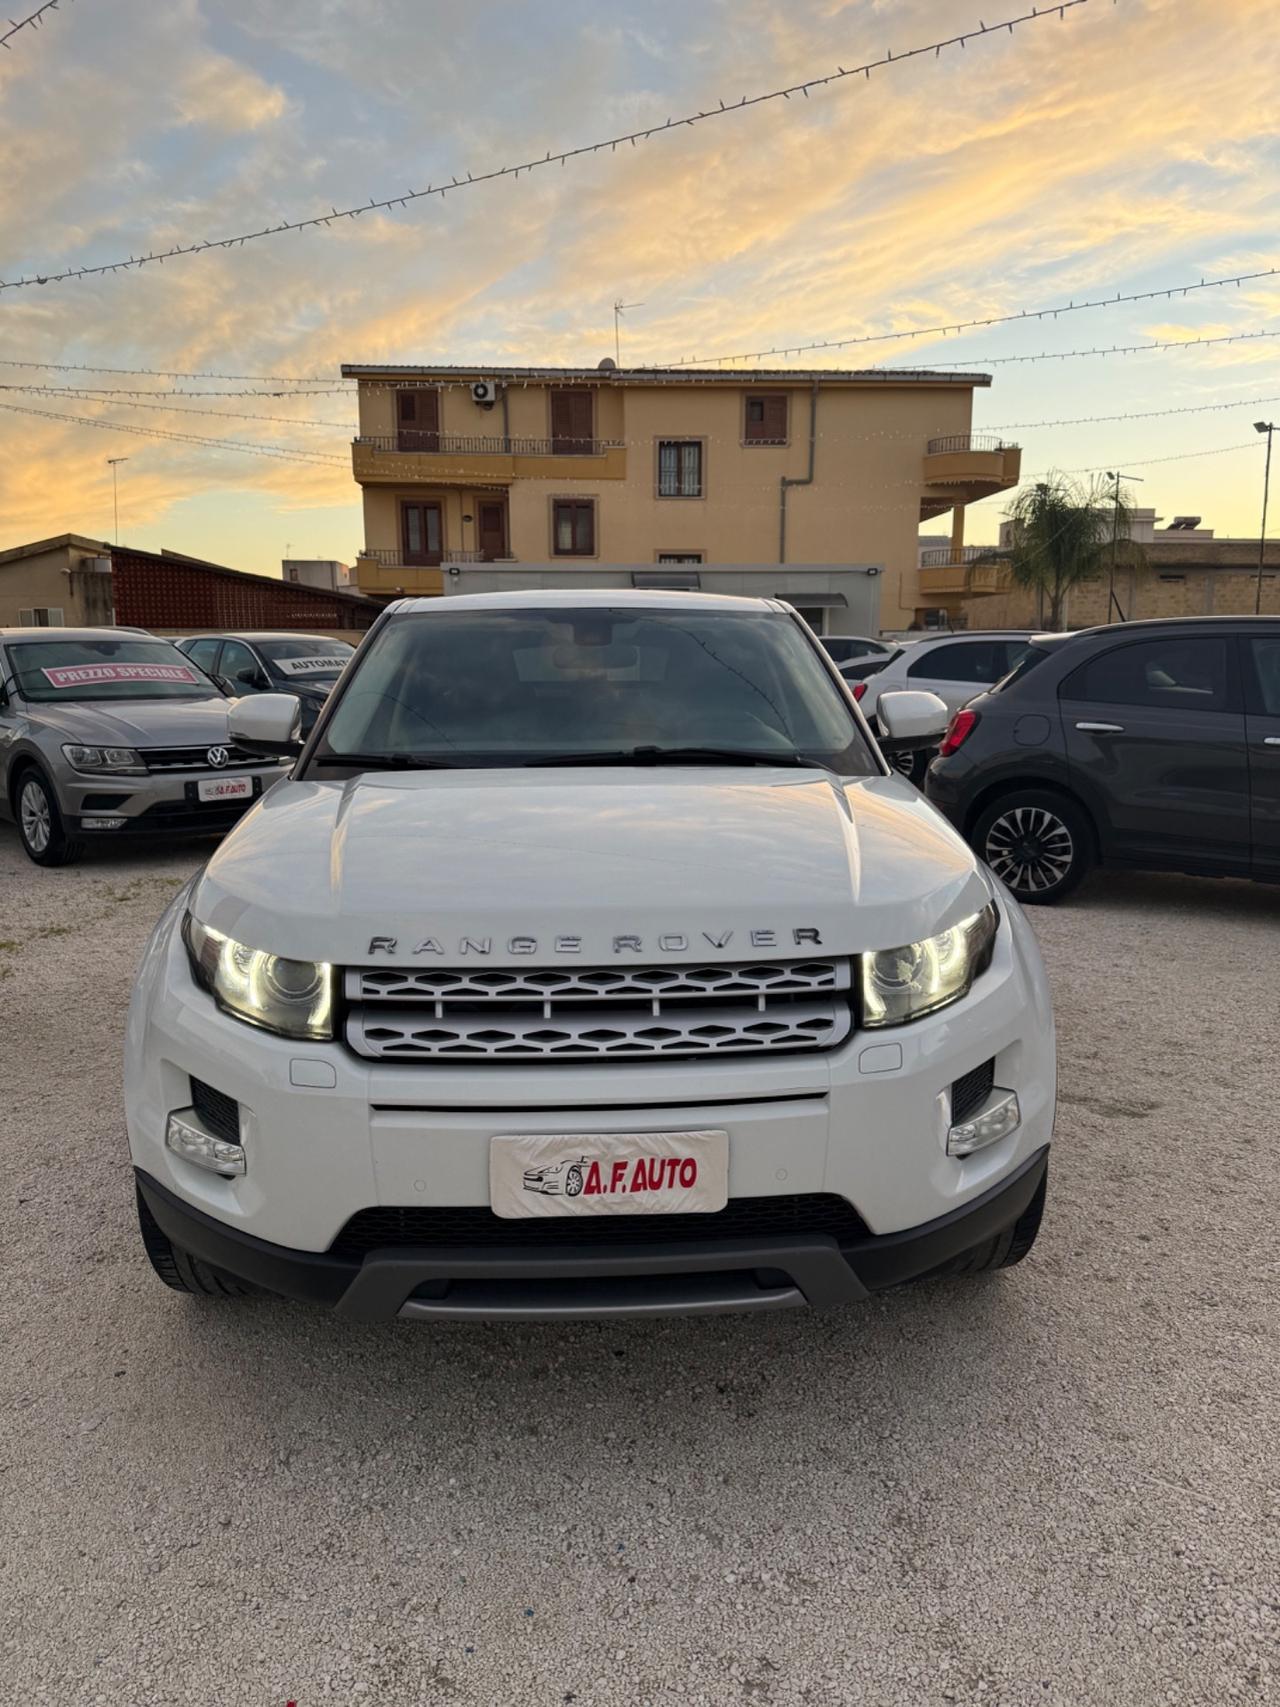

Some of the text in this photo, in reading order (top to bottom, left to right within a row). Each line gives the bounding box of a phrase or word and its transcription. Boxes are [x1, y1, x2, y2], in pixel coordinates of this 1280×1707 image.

[291, 659, 349, 670] AUTOMAT
[55, 666, 188, 682] PREZZO SPECIALE
[367, 927, 823, 956] RANGE ROVER
